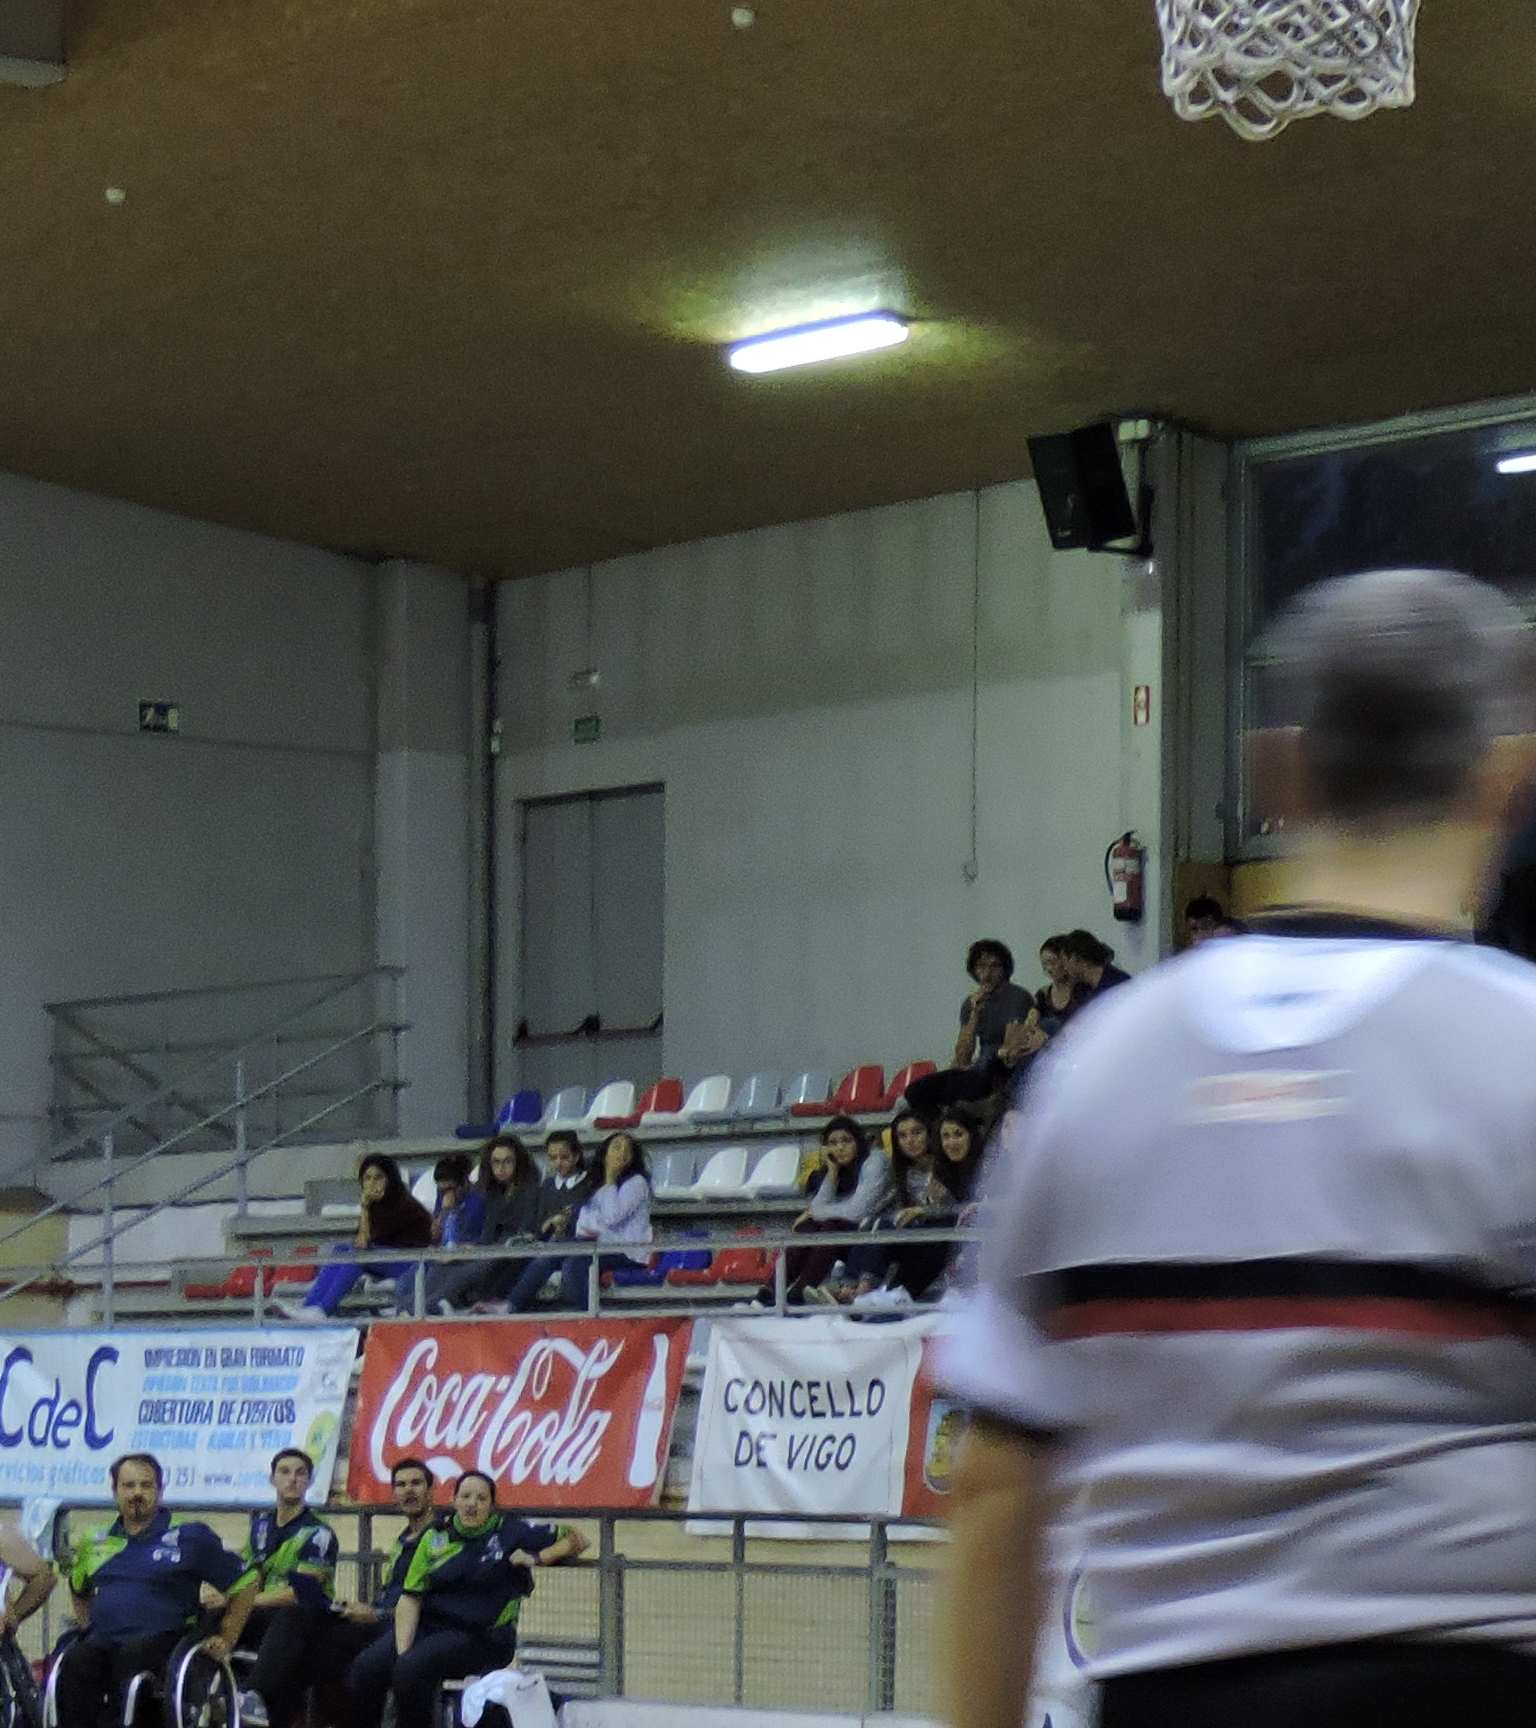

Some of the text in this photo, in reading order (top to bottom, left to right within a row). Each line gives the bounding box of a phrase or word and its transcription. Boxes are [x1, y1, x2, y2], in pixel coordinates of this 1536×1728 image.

[137, 1397, 296, 1425] COBERTURA DE EVENTOS
[370, 1337, 625, 1486] Coca-Cola
[724, 1377, 886, 1419] CONCELLO
[734, 1432, 857, 1471] DE VIGO
